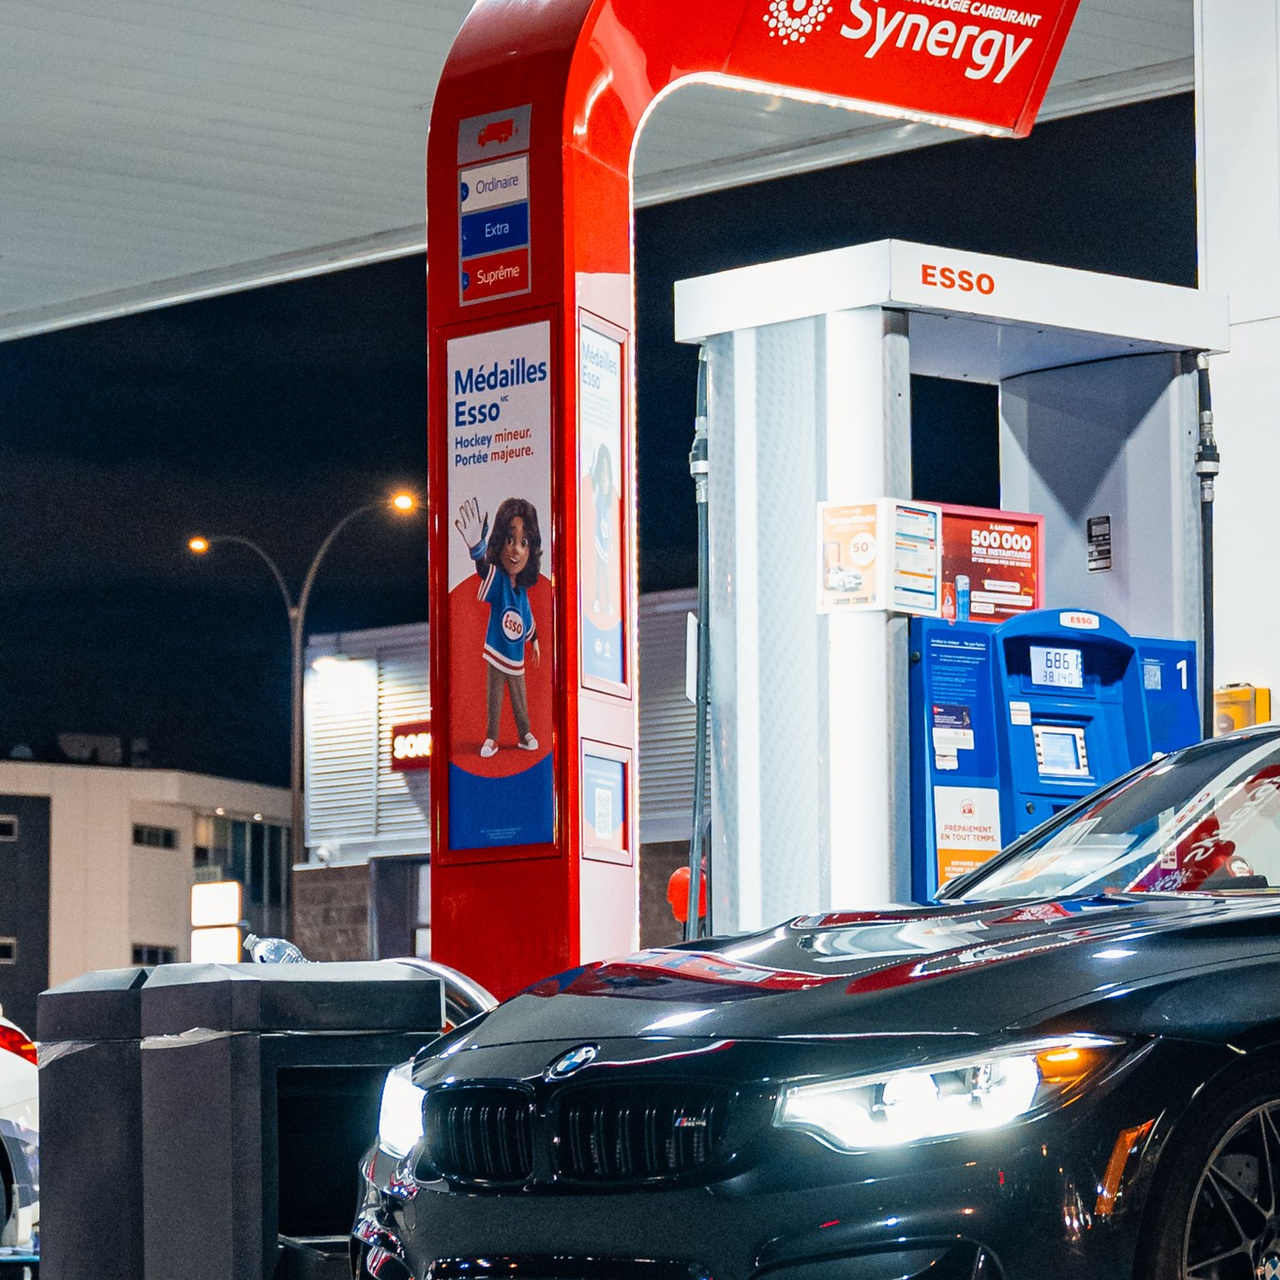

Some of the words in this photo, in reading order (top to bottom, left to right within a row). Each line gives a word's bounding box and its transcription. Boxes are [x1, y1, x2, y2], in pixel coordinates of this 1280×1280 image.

[970, 1, 1042, 28] CARBURANT
[476, 174, 519, 195] Ordinaire
[485, 222, 509, 238] Extra
[477, 265, 520, 286] Suprême
[922, 264, 995, 295] ESSO
[455, 357, 547, 396] Médailles
[455, 400, 500, 427] Esso
[455, 433, 492, 449] Hockey
[494, 427, 532, 444] mineur.
[455, 450, 488, 467] Portée
[490, 445, 534, 464] majeure.
[971, 529, 1001, 548] 500
[1001, 532, 1032, 551] 000
[1070, 615, 1093, 625] ESSO
[1176, 659, 1187, 690] 1
[944, 823, 992, 833] PRÉPAIEMENT
